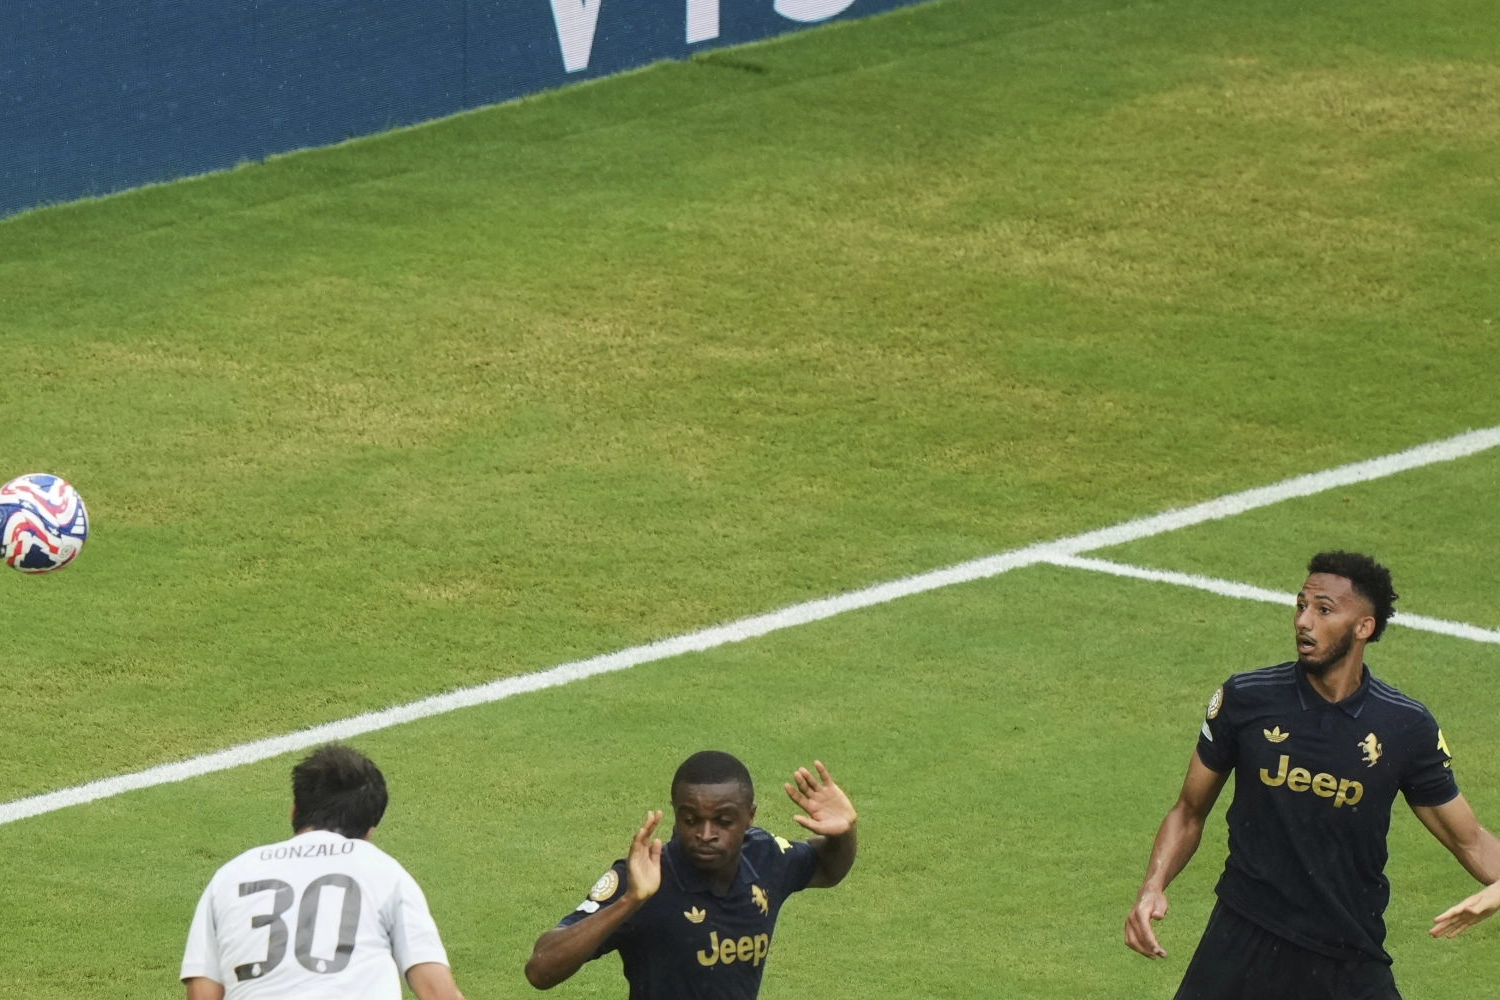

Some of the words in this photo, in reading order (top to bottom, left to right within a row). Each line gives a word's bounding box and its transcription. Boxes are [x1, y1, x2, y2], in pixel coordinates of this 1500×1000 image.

[1260, 754, 1364, 808] Jeep
[259, 840, 355, 862] GONZALO
[234, 873, 362, 983] 30
[697, 931, 770, 967] Jeep
